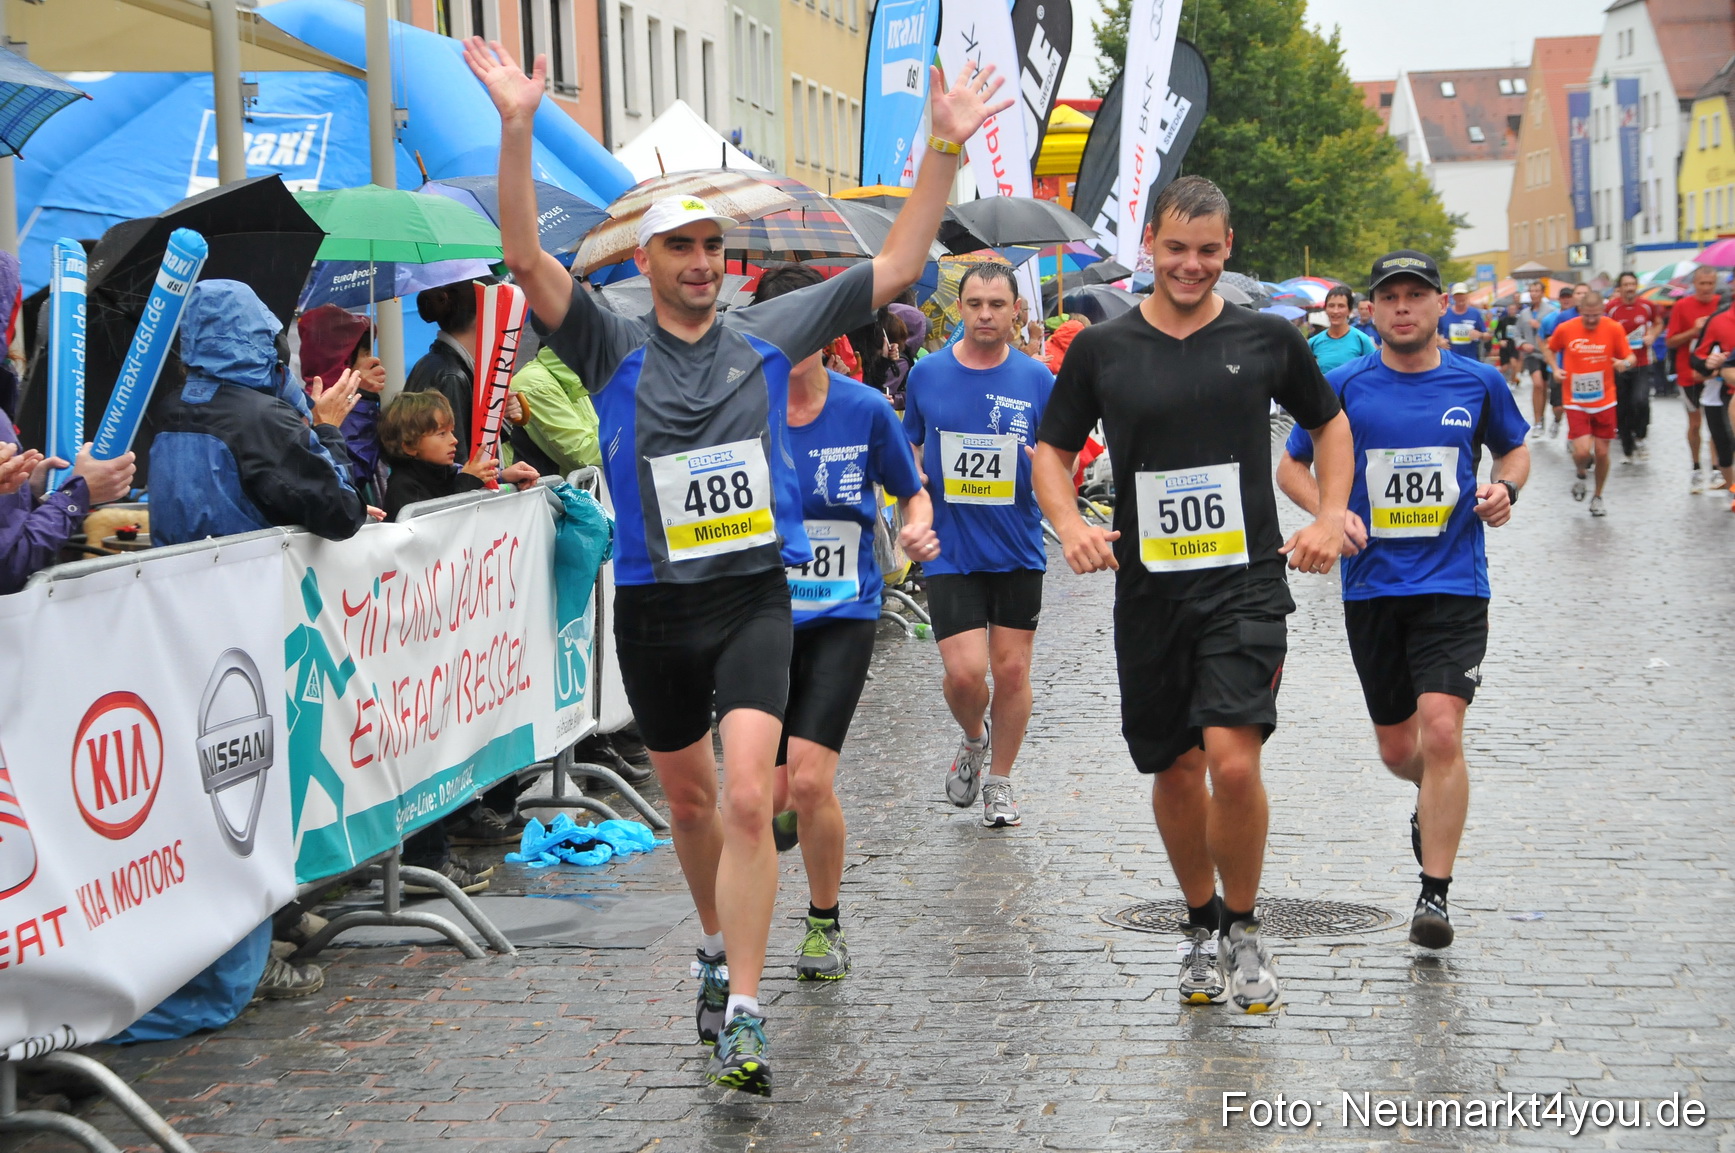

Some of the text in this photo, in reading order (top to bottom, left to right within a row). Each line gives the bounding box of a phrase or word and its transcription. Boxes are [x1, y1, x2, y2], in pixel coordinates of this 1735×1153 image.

[887, 6, 926, 49] maxi
[907, 64, 920, 90] dsl
[1039, 58, 1058, 109] SWEDEN
[1163, 104, 1186, 146] SWEDEN
[1128, 65, 1155, 223] Audi BKK
[166, 280, 183, 293] dsl
[95, 296, 167, 456] www.maxi-dsl.de
[476, 326, 522, 457] AUSTRIA
[985, 393, 1032, 408] 12. NEUMARKTER
[994, 400, 1026, 412] STADTLAUF
[1444, 418, 1470, 428] MAN
[808, 444, 869, 458] 12. NEUMARKTER
[962, 437, 994, 447] BOCK
[688, 450, 734, 469] BOCK
[819, 452, 859, 464] STADTLAUF
[953, 452, 1002, 479] 424
[1393, 452, 1432, 464] BOCK
[684, 470, 754, 517] 488
[960, 483, 992, 495] Albert
[1165, 473, 1209, 488] BOCK
[1384, 470, 1444, 504] 484
[1158, 493, 1226, 535] 506
[1389, 510, 1439, 525] Michael
[694, 518, 752, 542] Michael
[1170, 539, 1218, 557] Tobias
[400, 558, 442, 647] UNS
[86, 723, 151, 811] KIA
[202, 729, 266, 779] NISSAN
[75, 839, 185, 931] KIA MOTORS
